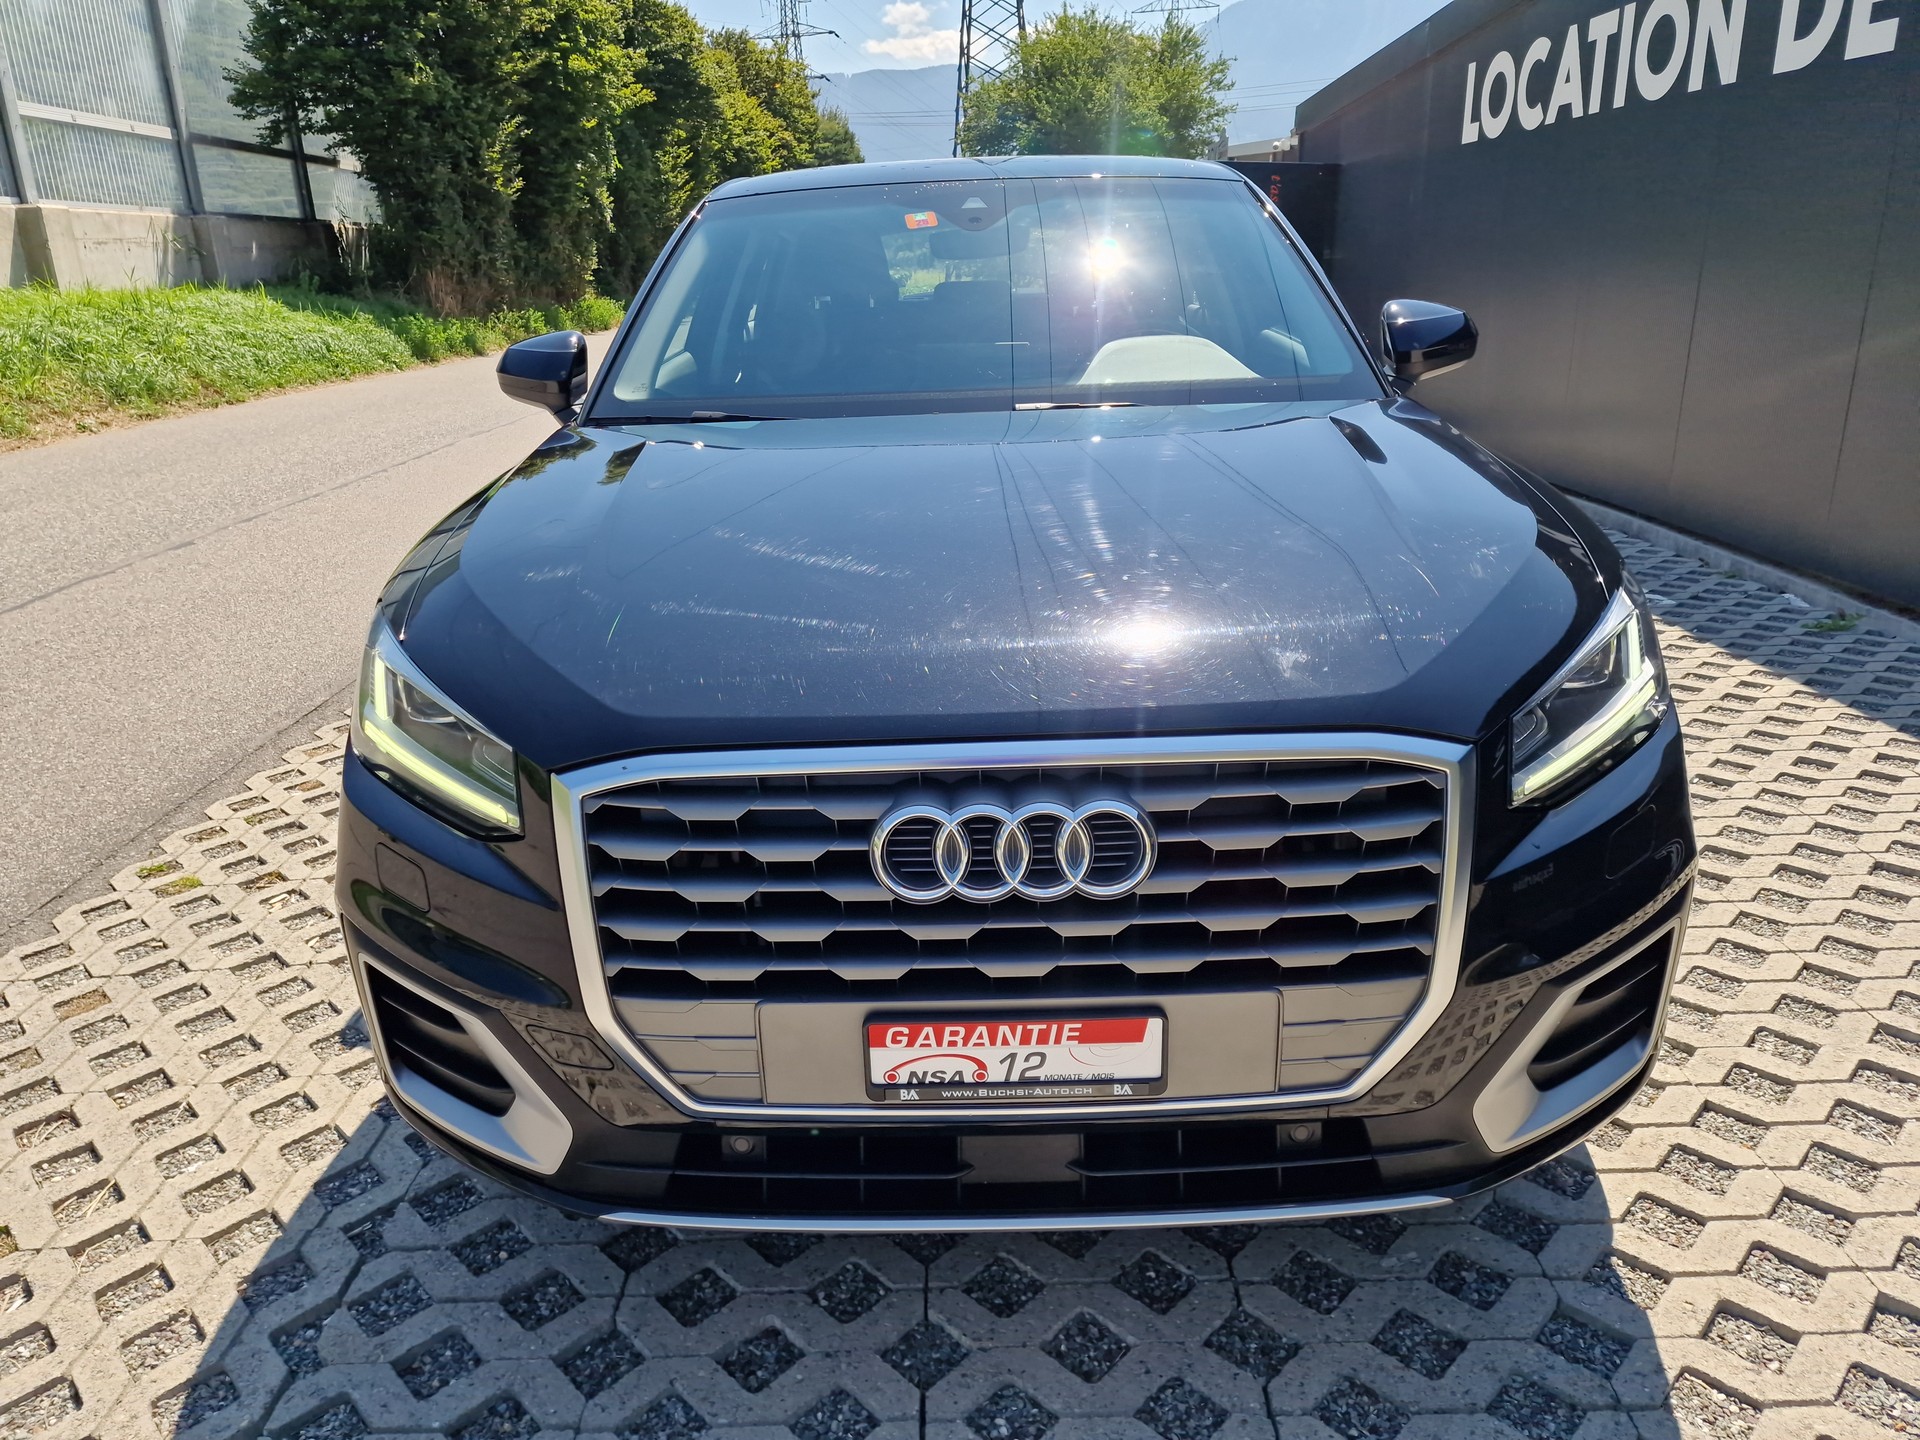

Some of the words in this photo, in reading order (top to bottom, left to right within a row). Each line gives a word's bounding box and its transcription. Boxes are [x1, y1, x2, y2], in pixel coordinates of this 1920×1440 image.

[1461, 0, 1748, 144] LOCATION
[885, 1023, 1082, 1049] GARANTIE
[907, 1070, 965, 1085] NSA
[999, 1052, 1047, 1082] 12
[1044, 1073, 1084, 1081] MONATE
[1091, 1072, 1115, 1080] MOIS
